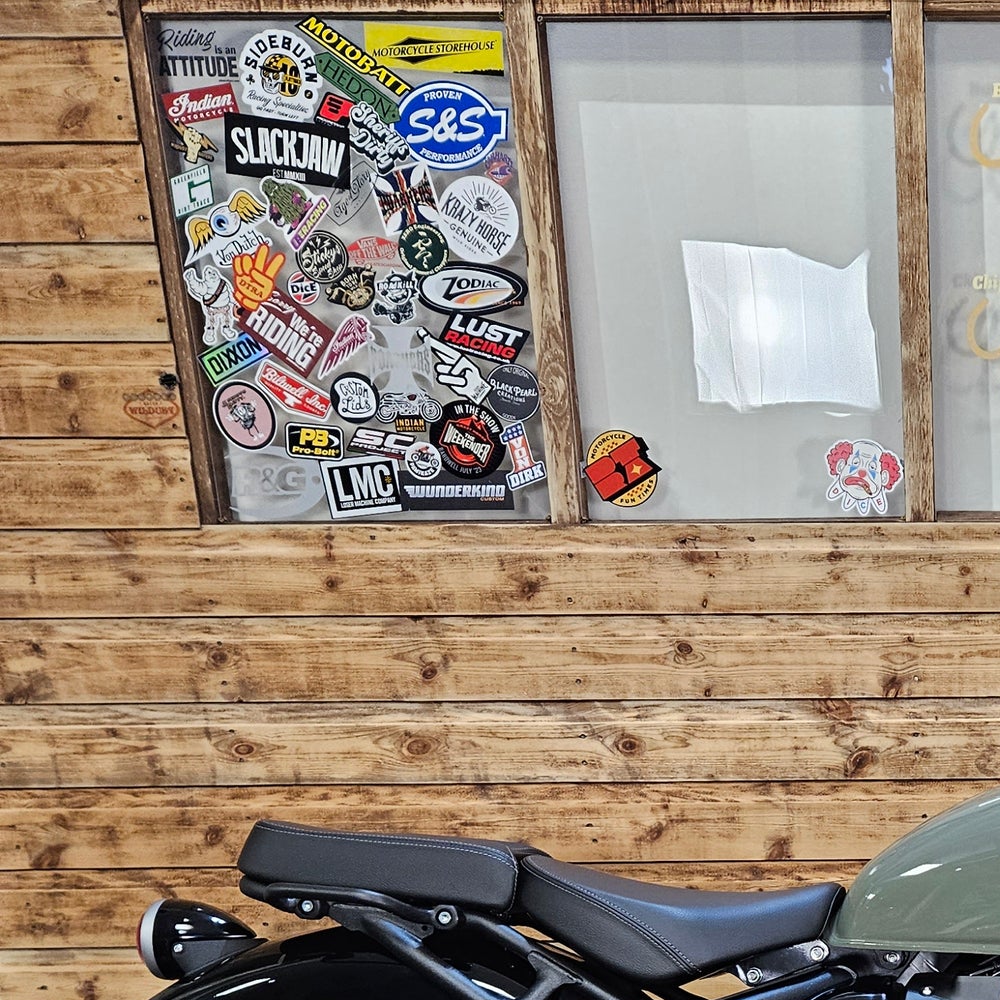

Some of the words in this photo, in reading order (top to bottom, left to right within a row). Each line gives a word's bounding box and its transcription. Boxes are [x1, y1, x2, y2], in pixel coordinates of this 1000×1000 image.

[158, 28, 216, 51] Riding
[215, 46, 221, 54] is
[225, 46, 236, 54] an
[372, 44, 434, 57] MOTORCYCLE
[436, 40, 496, 53] STOREHOUSE
[160, 56, 239, 77] ATTITUDE
[244, 34, 318, 84] SIDEBURN
[302, 16, 411, 96] MOTOBATT
[322, 59, 391, 118] HEDON
[423, 90, 463, 102] PROVEN
[168, 92, 233, 117] Indian
[406, 106, 486, 144] S&S
[230, 126, 346, 178] SLACKJAW
[419, 143, 483, 162] PERFORMANCE
[440, 191, 478, 228] KRAZY
[475, 218, 511, 256] HORSE
[449, 222, 487, 254] GENUINE
[238, 278, 265, 299] DTRA
[442, 276, 501, 301] ZODIAC
[245, 305, 317, 369] RIDING
[449, 313, 523, 347] LUST
[206, 336, 262, 376] DIXXON
[444, 330, 516, 359] RACING
[395, 418, 425, 427] INDIAN
[453, 404, 464, 415] IN
[465, 403, 479, 416] THE
[479, 410, 501, 434] SHOW
[299, 427, 330, 447] PB
[443, 423, 491, 464] WEEKENDER
[590, 433, 626, 460] MOTORCYCLE
[292, 445, 336, 457] Pro-Bolt
[332, 463, 394, 502] LMC
[508, 465, 544, 488] DIRK
[637, 479, 654, 500] TIMES
